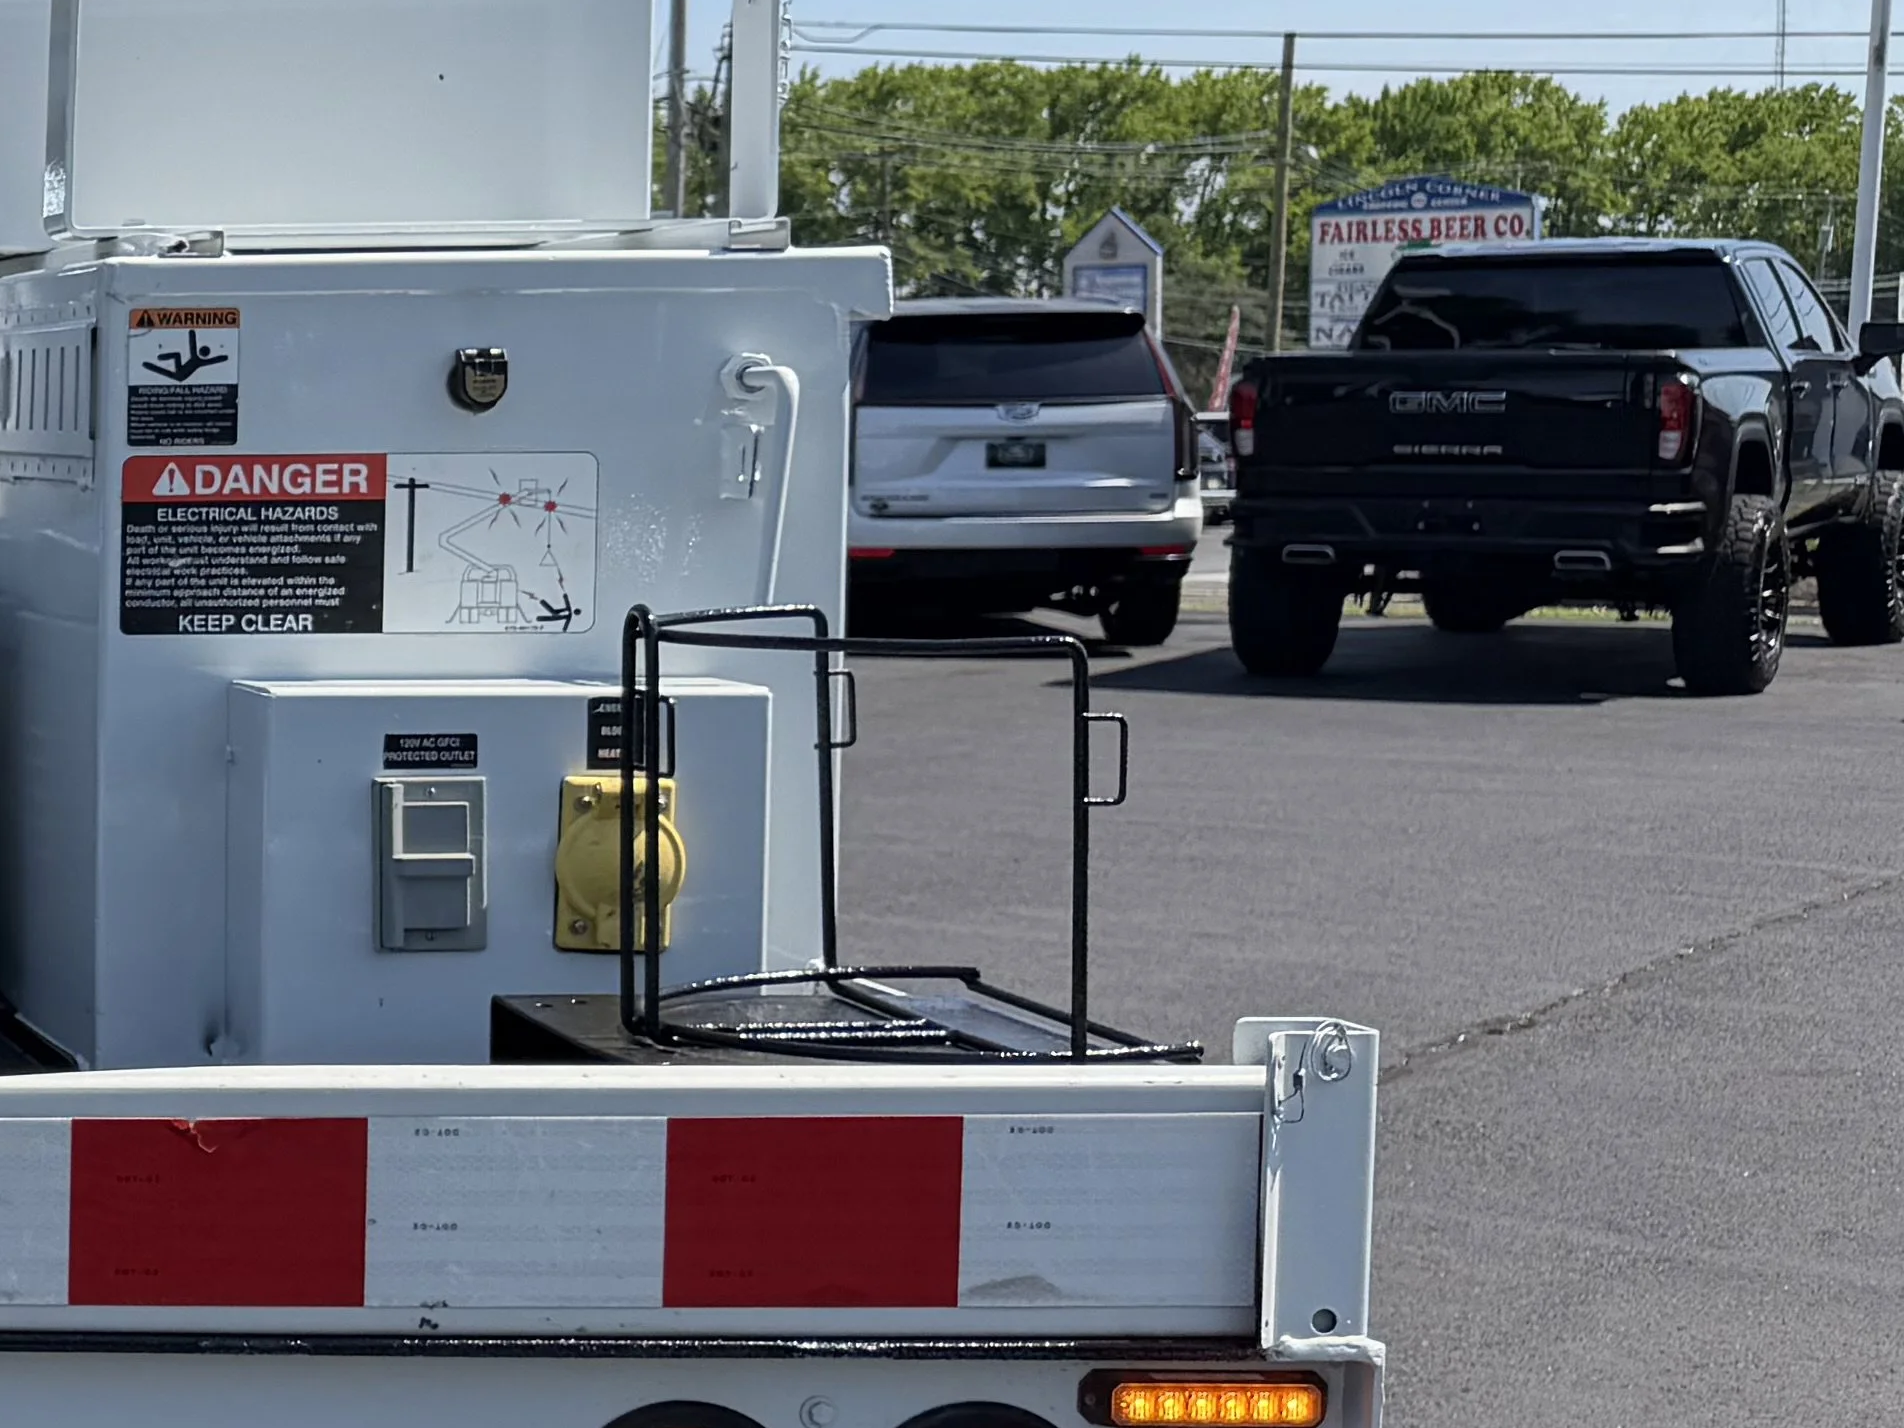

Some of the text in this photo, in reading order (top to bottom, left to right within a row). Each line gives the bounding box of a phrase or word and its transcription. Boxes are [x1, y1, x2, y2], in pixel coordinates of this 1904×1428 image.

[1319, 214, 1531, 245] FAIRLESS BEER CO.
[157, 312, 237, 325] WARNING
[1389, 390, 1506, 413] GMC
[195, 462, 369, 495] DANGER
[157, 506, 339, 522] ELECTRICAL HAZARDS
[178, 613, 314, 632] KEEP CLEAR
[384, 750, 475, 762] PROTECTED OUTLET
[597, 747, 621, 759] HEAT
